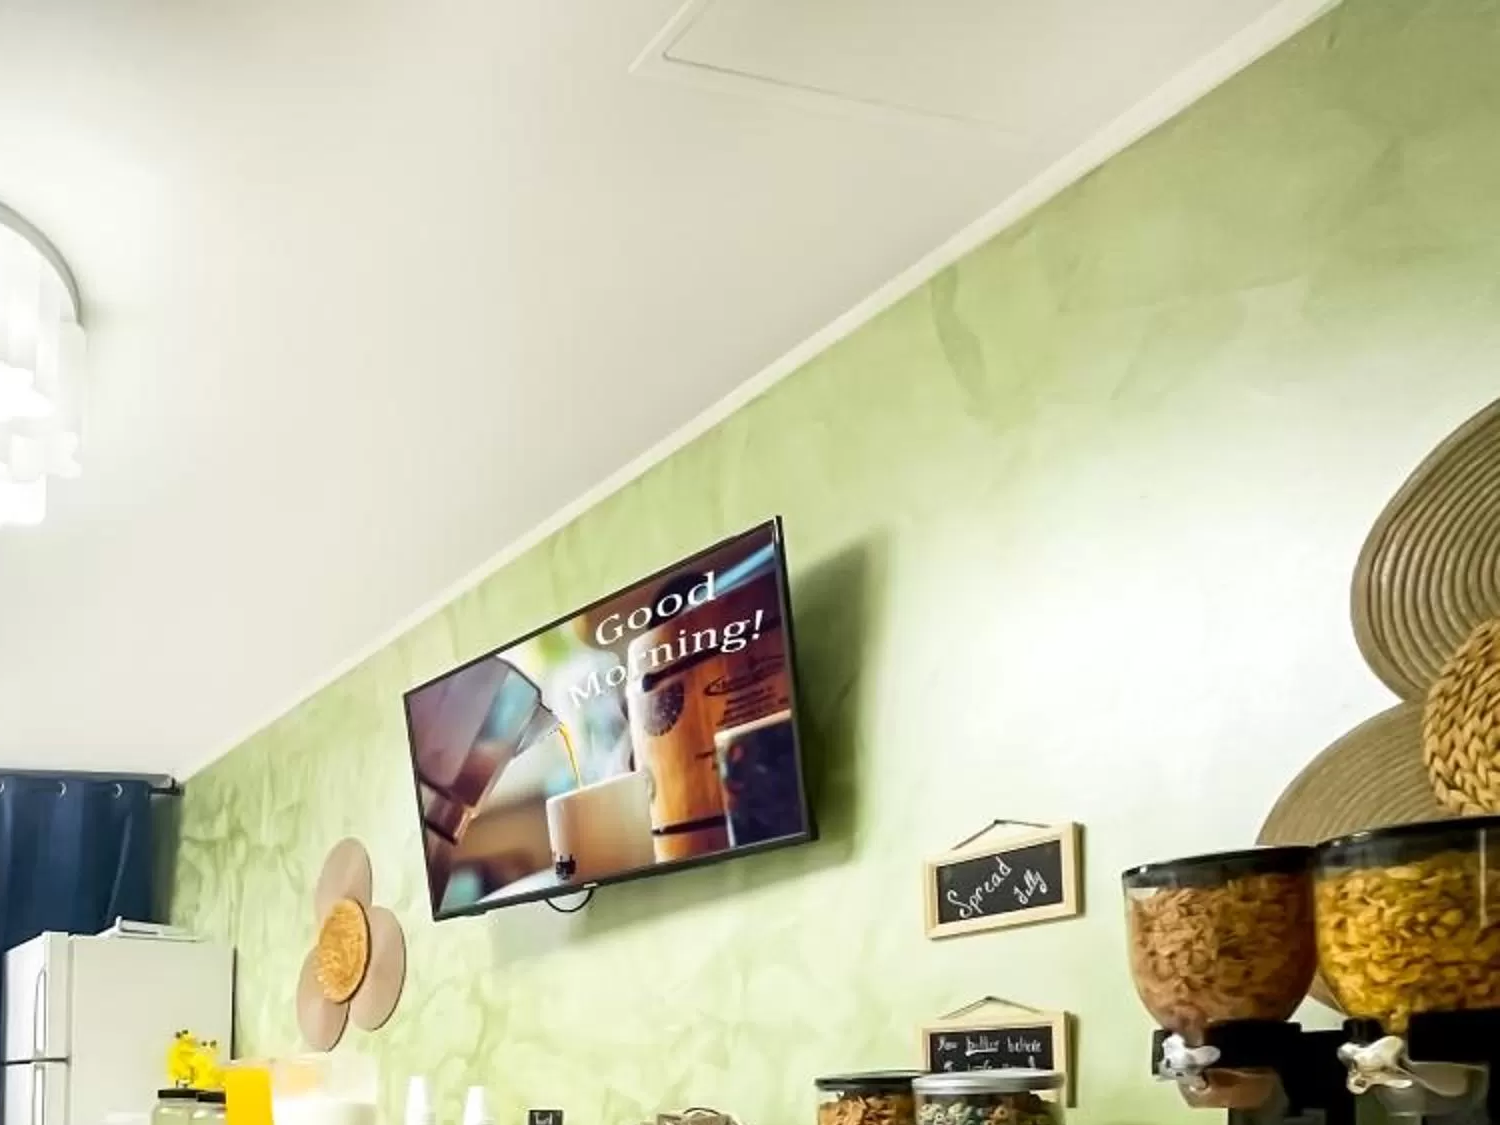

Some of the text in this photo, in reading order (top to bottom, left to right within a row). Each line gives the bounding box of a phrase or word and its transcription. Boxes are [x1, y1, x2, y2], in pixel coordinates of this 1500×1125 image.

[595, 571, 716, 646] Good
[568, 608, 765, 709] Morning!
[946, 855, 1012, 919] Spread
